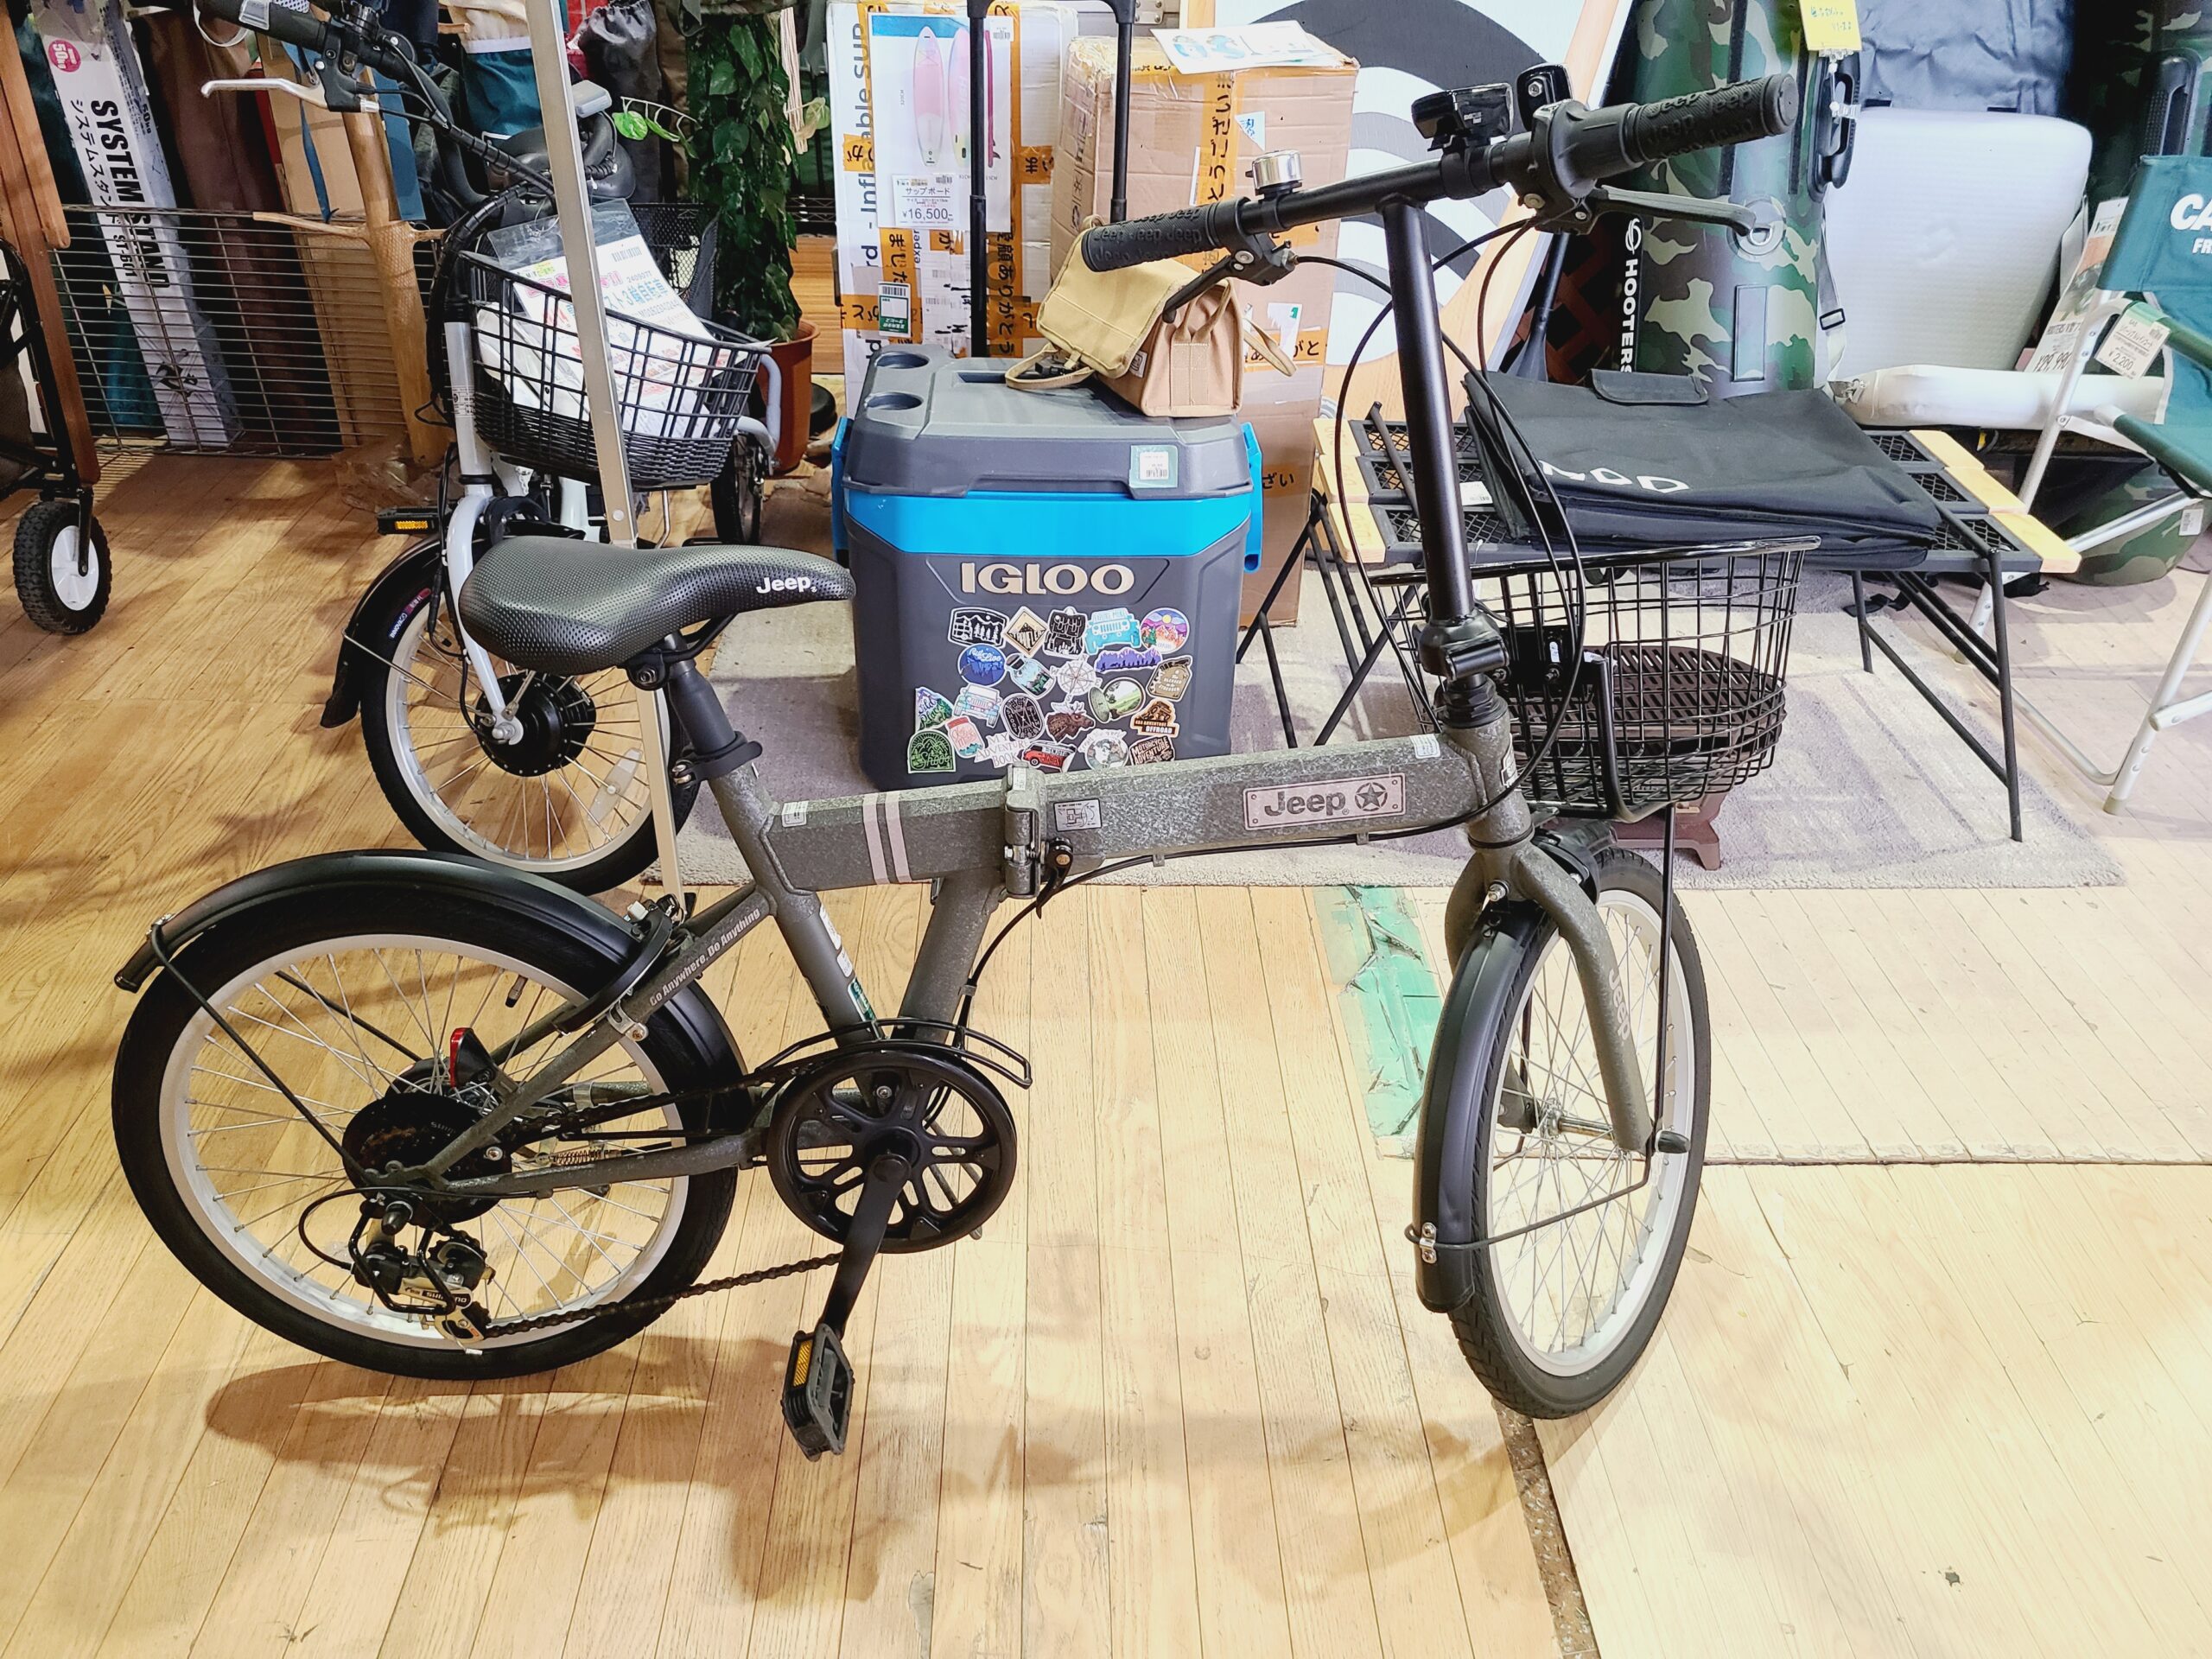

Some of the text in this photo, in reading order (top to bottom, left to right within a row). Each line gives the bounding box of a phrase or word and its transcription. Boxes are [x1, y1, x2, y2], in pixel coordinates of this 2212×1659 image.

[90, 100, 146, 203] SYSTEM
[906, 187, 950, 196] サップボード
[756, 575, 812, 594] Jeep
[961, 562, 1135, 595] IGLOO
[1264, 791, 1346, 817] Jeep
[707, 942, 721, 957] Do
[721, 908, 761, 947] Anything
[1608, 968, 1630, 1041] Jeep
